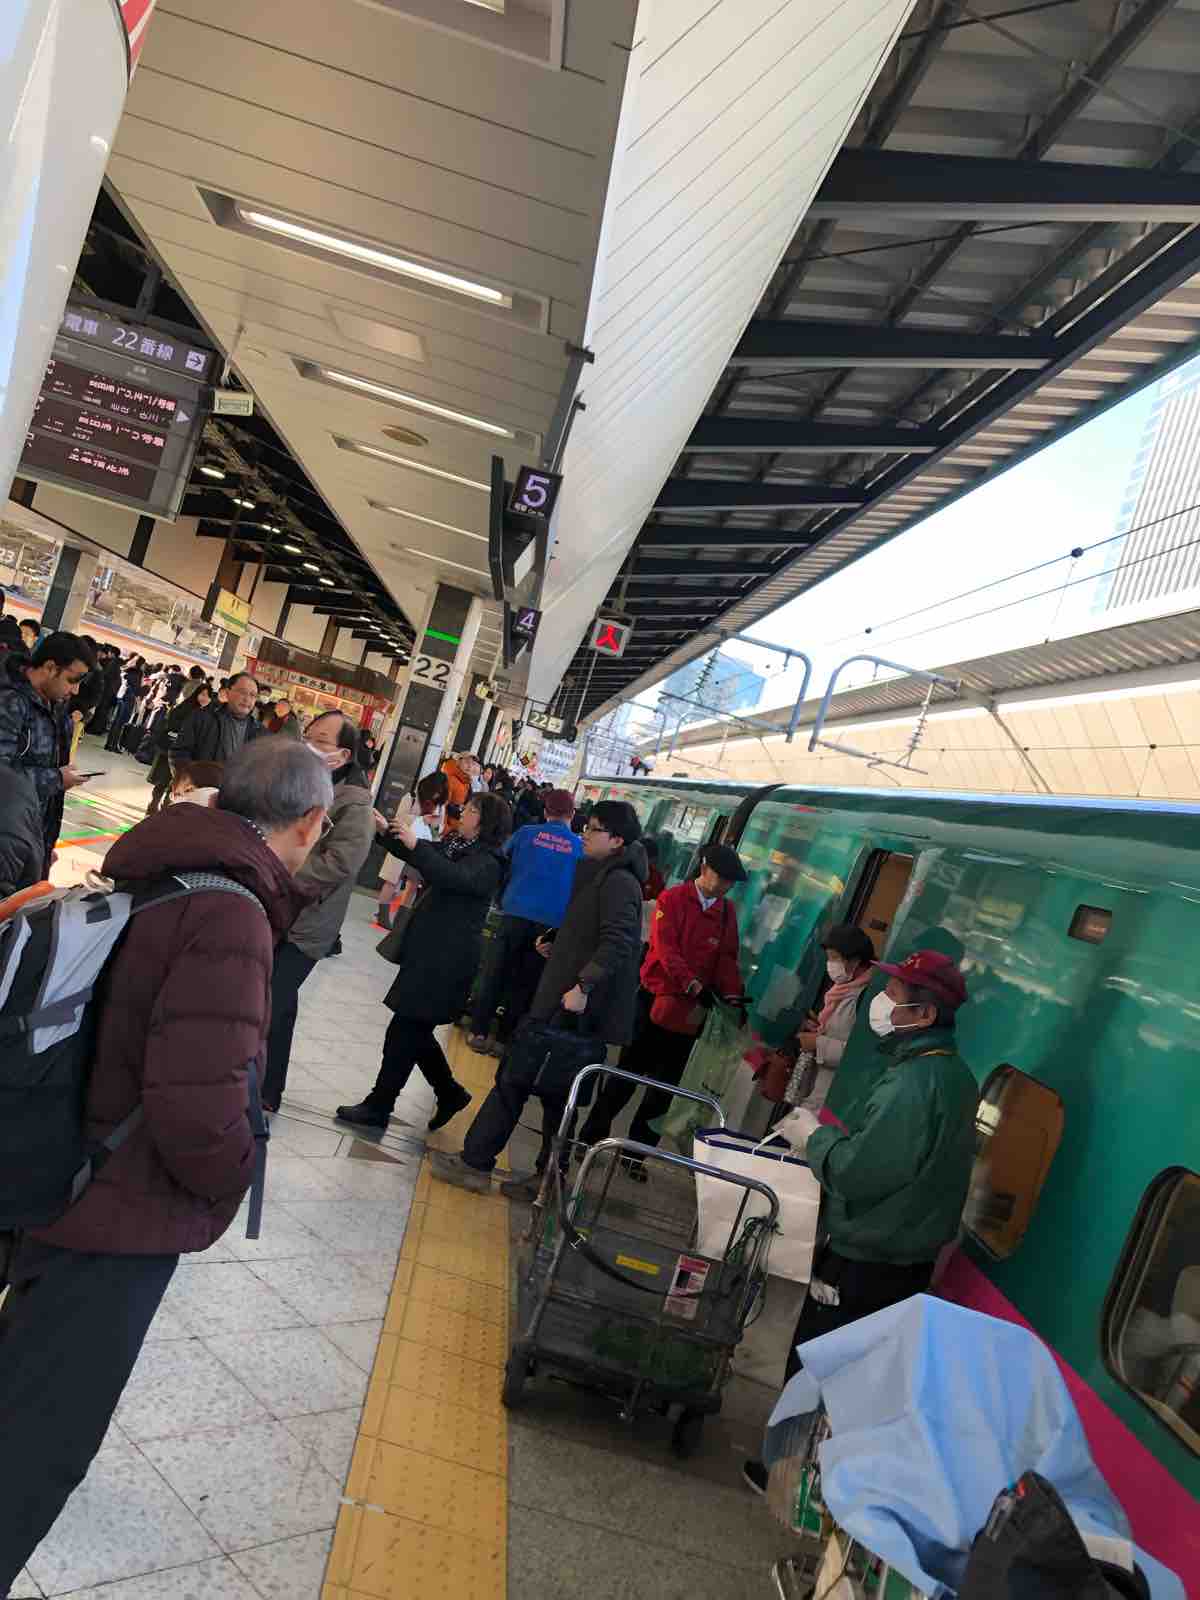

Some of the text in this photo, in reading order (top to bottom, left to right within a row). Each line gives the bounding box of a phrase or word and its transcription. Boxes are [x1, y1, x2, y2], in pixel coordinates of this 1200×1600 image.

[523, 475, 550, 507] 5
[519, 611, 535, 630] 4
[414, 657, 450, 684] 22
